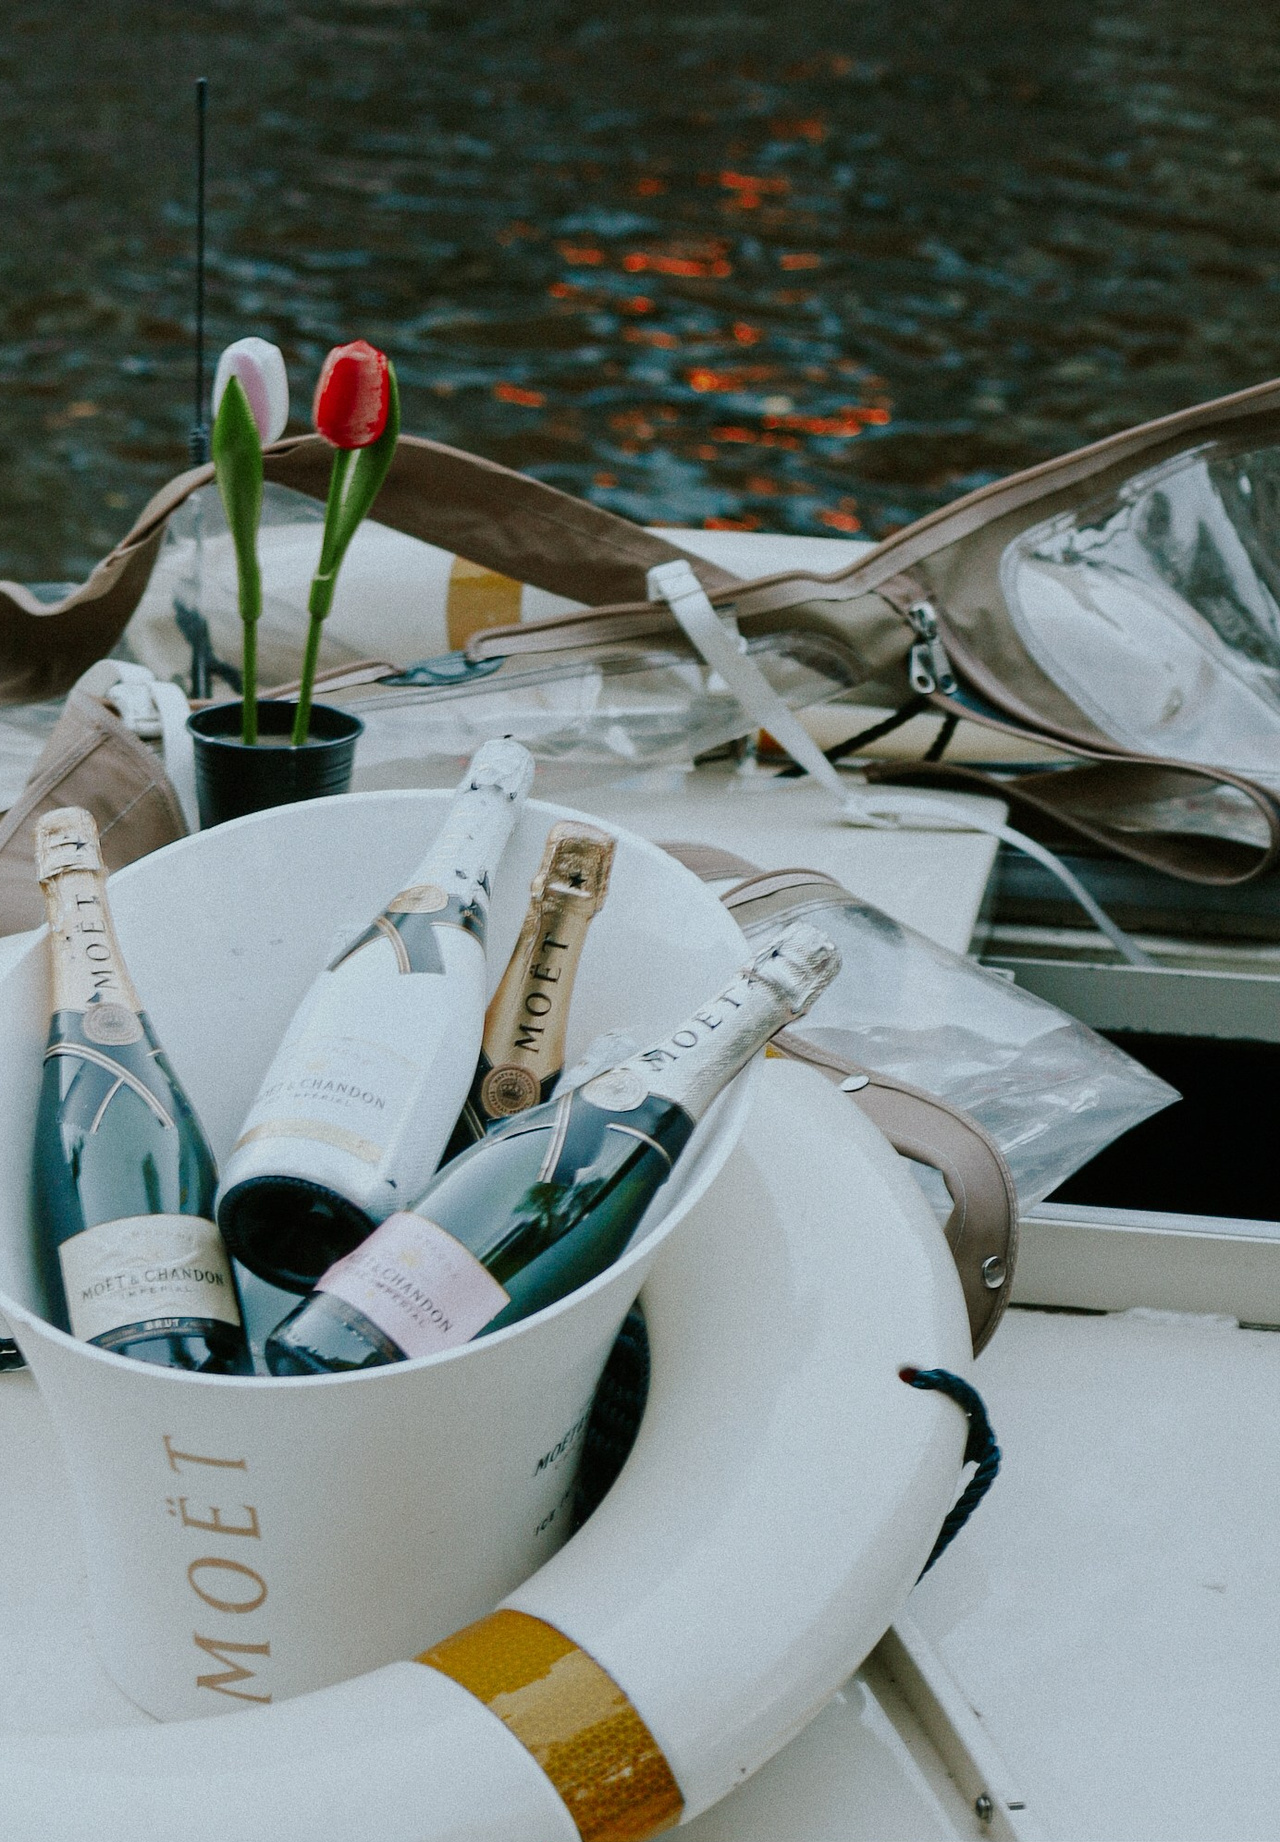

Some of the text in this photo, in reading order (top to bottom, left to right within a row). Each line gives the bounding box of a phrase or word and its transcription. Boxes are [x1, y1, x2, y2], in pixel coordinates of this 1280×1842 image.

[514, 930, 570, 1054] MOËT
[299, 1078, 387, 1110] CHANDON
[144, 1267, 225, 1287] CHANDON
[381, 1266, 454, 1334] CHANDON
[162, 1434, 273, 1705] MOËT
